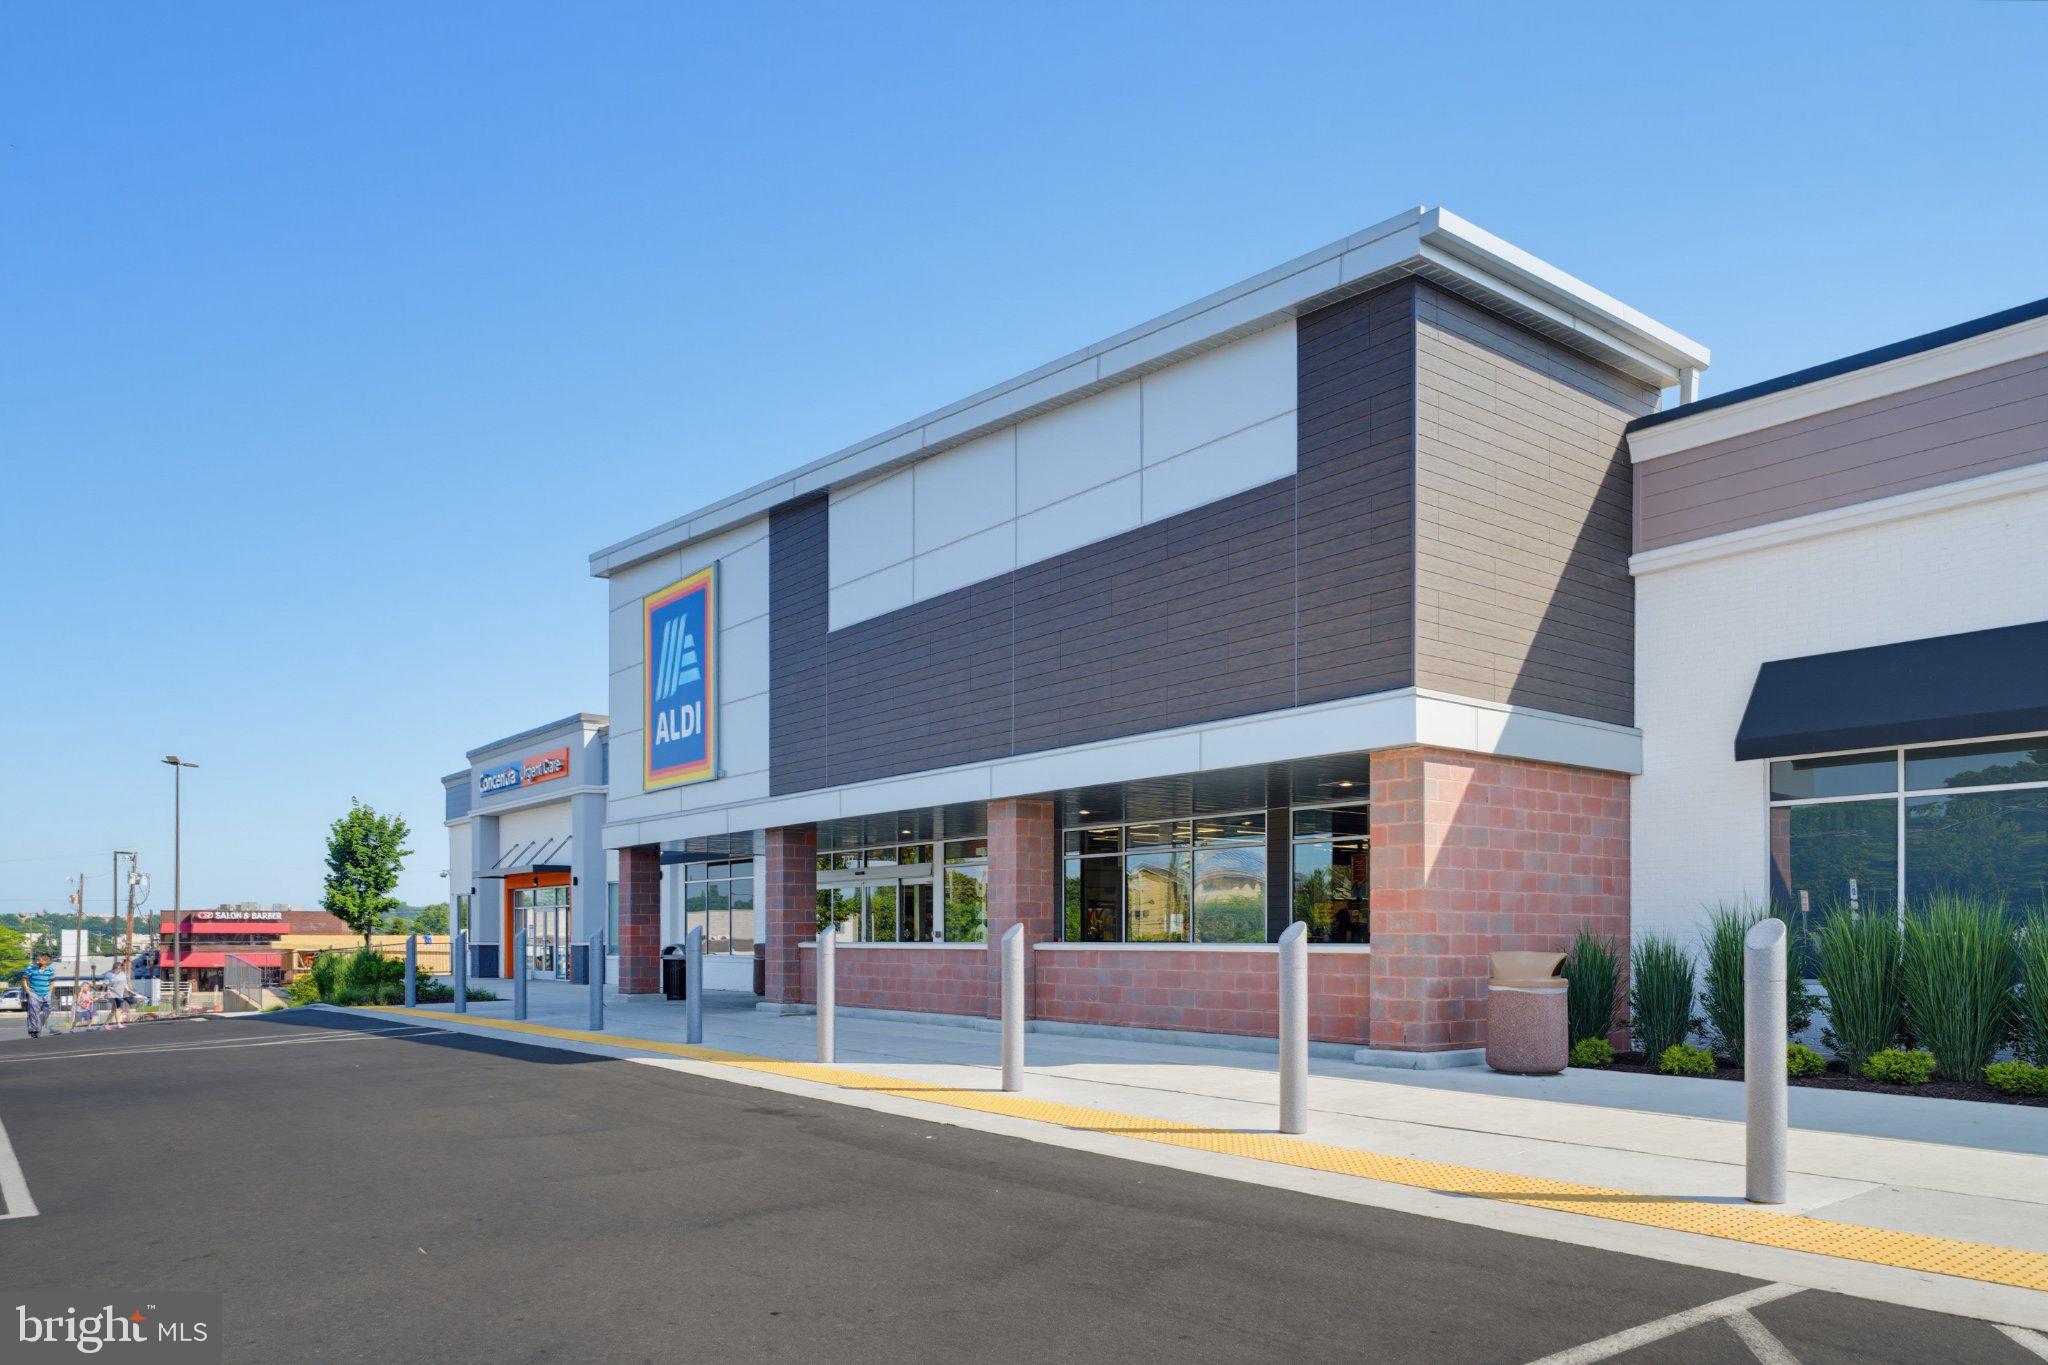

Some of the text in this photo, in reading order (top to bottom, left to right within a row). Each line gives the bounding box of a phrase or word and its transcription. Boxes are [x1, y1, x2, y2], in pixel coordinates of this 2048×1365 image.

[655, 701, 702, 745] ALDI
[521, 762, 543, 783] Urgent
[543, 758, 561, 775] Care
[215, 911, 242, 920] SALON
[251, 911, 282, 920] BARBER
